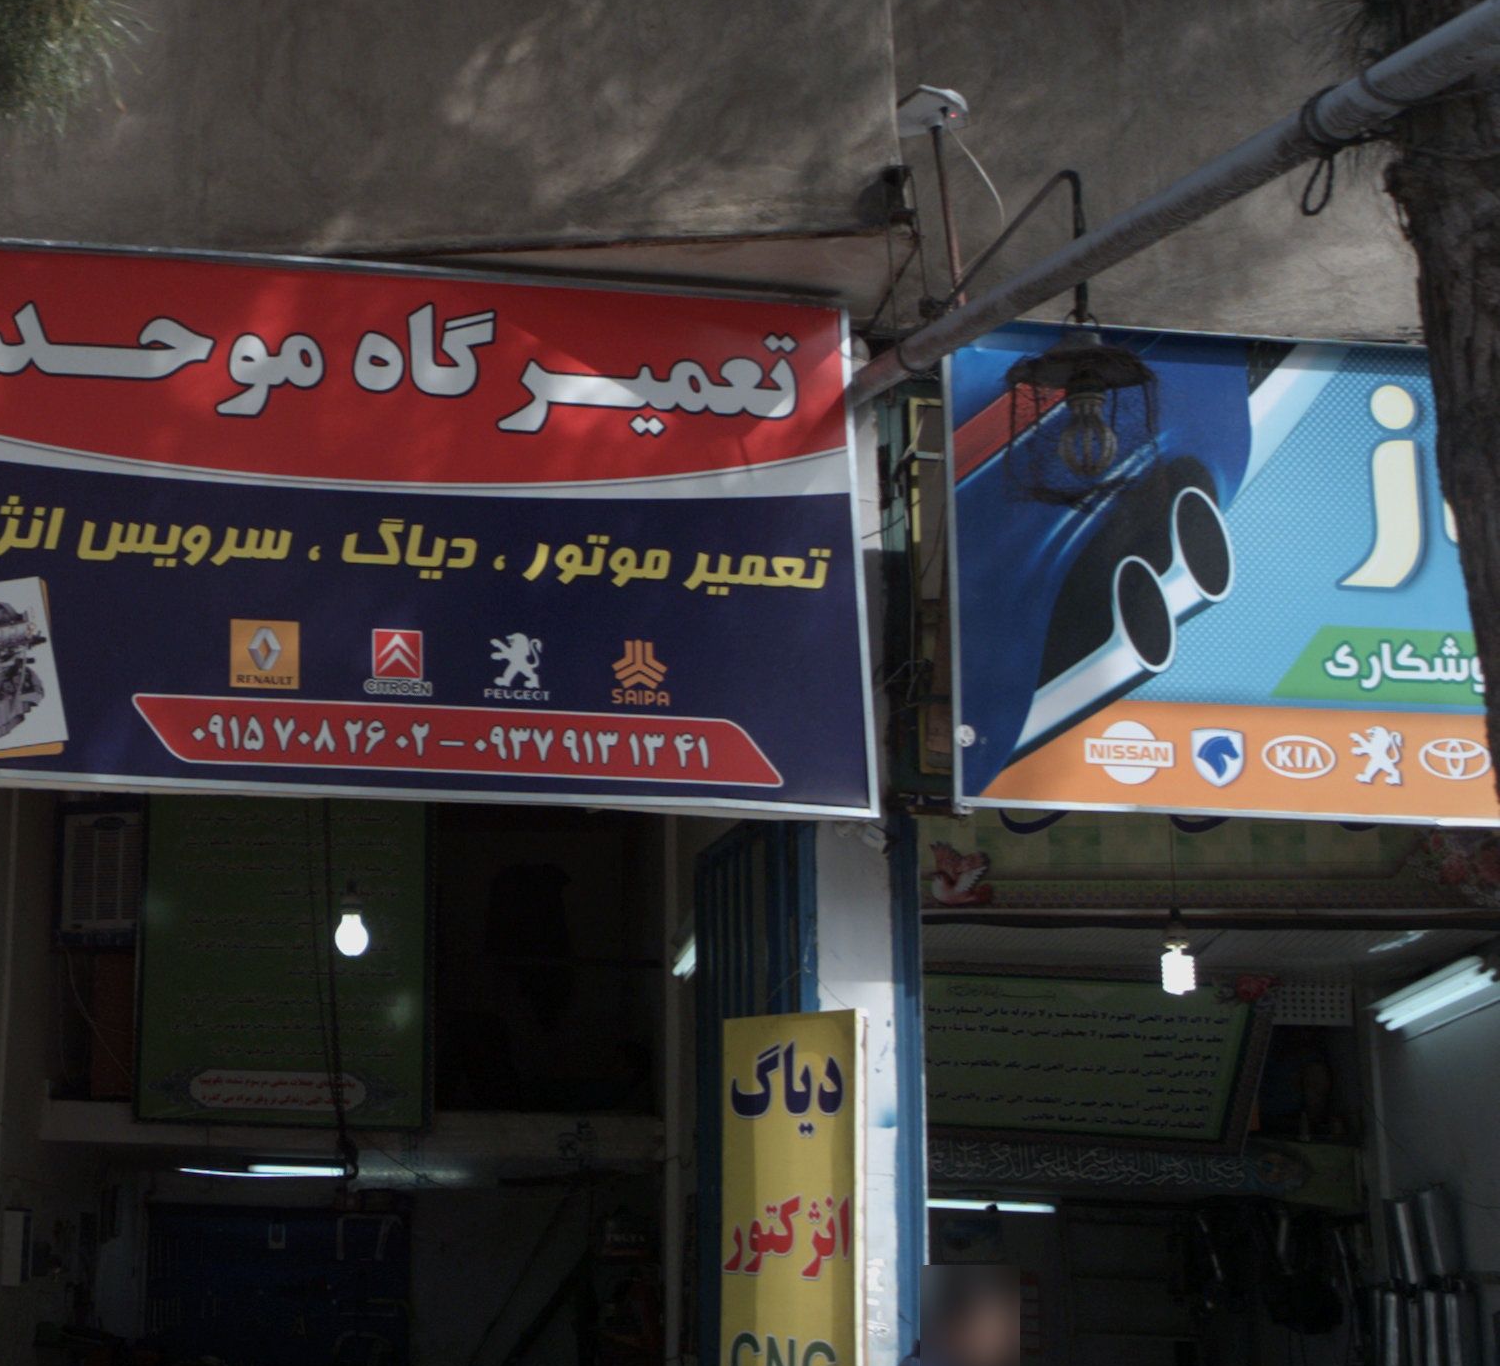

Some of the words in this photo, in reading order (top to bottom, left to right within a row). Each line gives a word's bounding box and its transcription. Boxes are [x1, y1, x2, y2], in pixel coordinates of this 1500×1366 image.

[76, 519, 293, 569] سرویس
[341, 517, 478, 581] دیاگ
[522, 533, 672, 587] موتور
[682, 547, 832, 597] تعمیر
[235, 674, 294, 685] RENAULT
[483, 688, 551, 702] PEUGEOT
[611, 688, 671, 708] SAIPA
[1088, 741, 1171, 764] NISSAN
[1275, 742, 1323, 770] KIA
[730, 1037, 846, 1137] دیاگ
[721, 1194, 853, 1280] انژکتور
